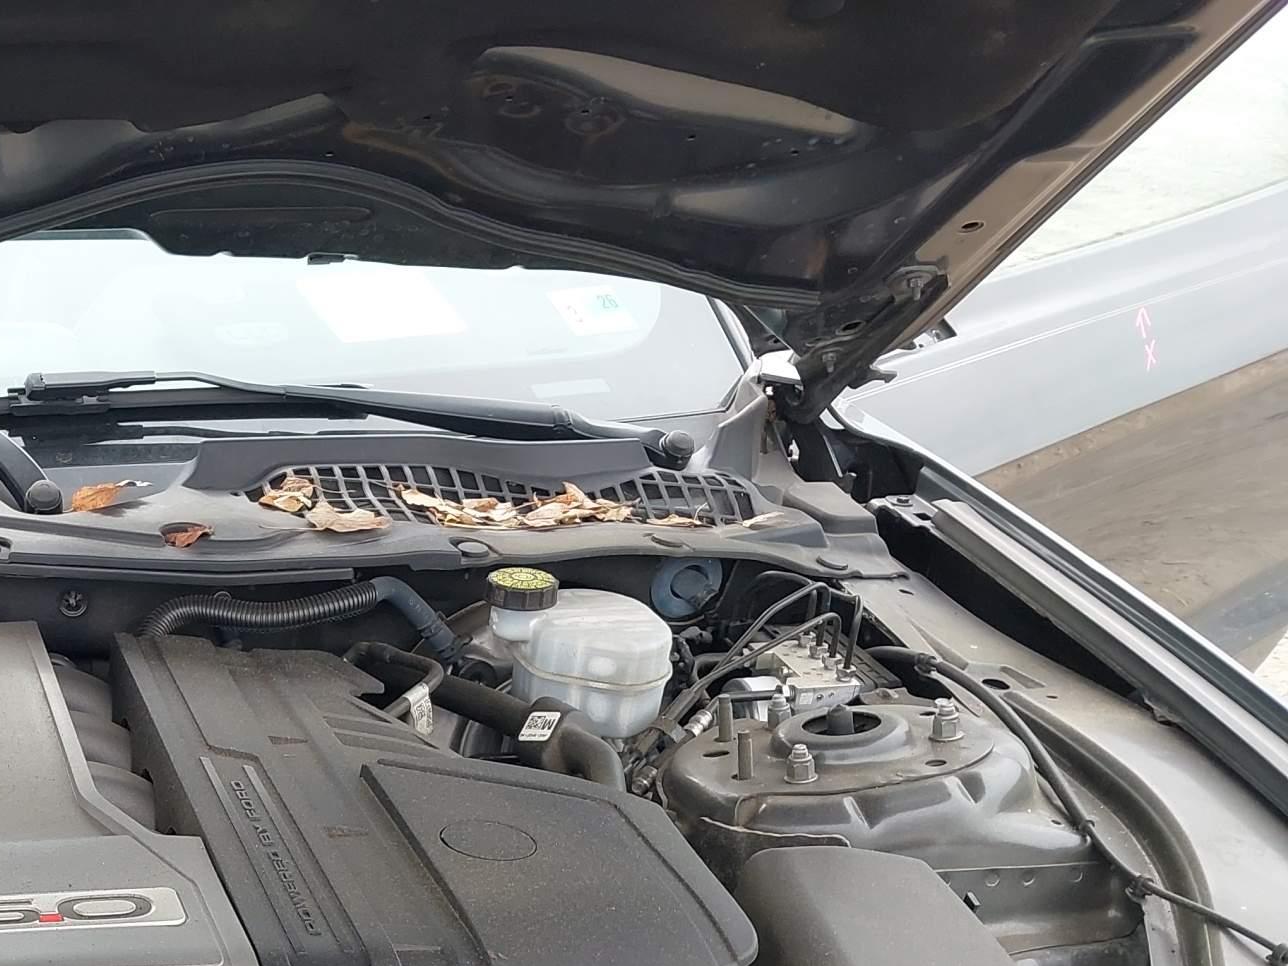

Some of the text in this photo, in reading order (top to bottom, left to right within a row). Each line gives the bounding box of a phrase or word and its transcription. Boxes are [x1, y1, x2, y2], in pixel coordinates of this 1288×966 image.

[230, 780, 322, 937] POWERED BY FORD
